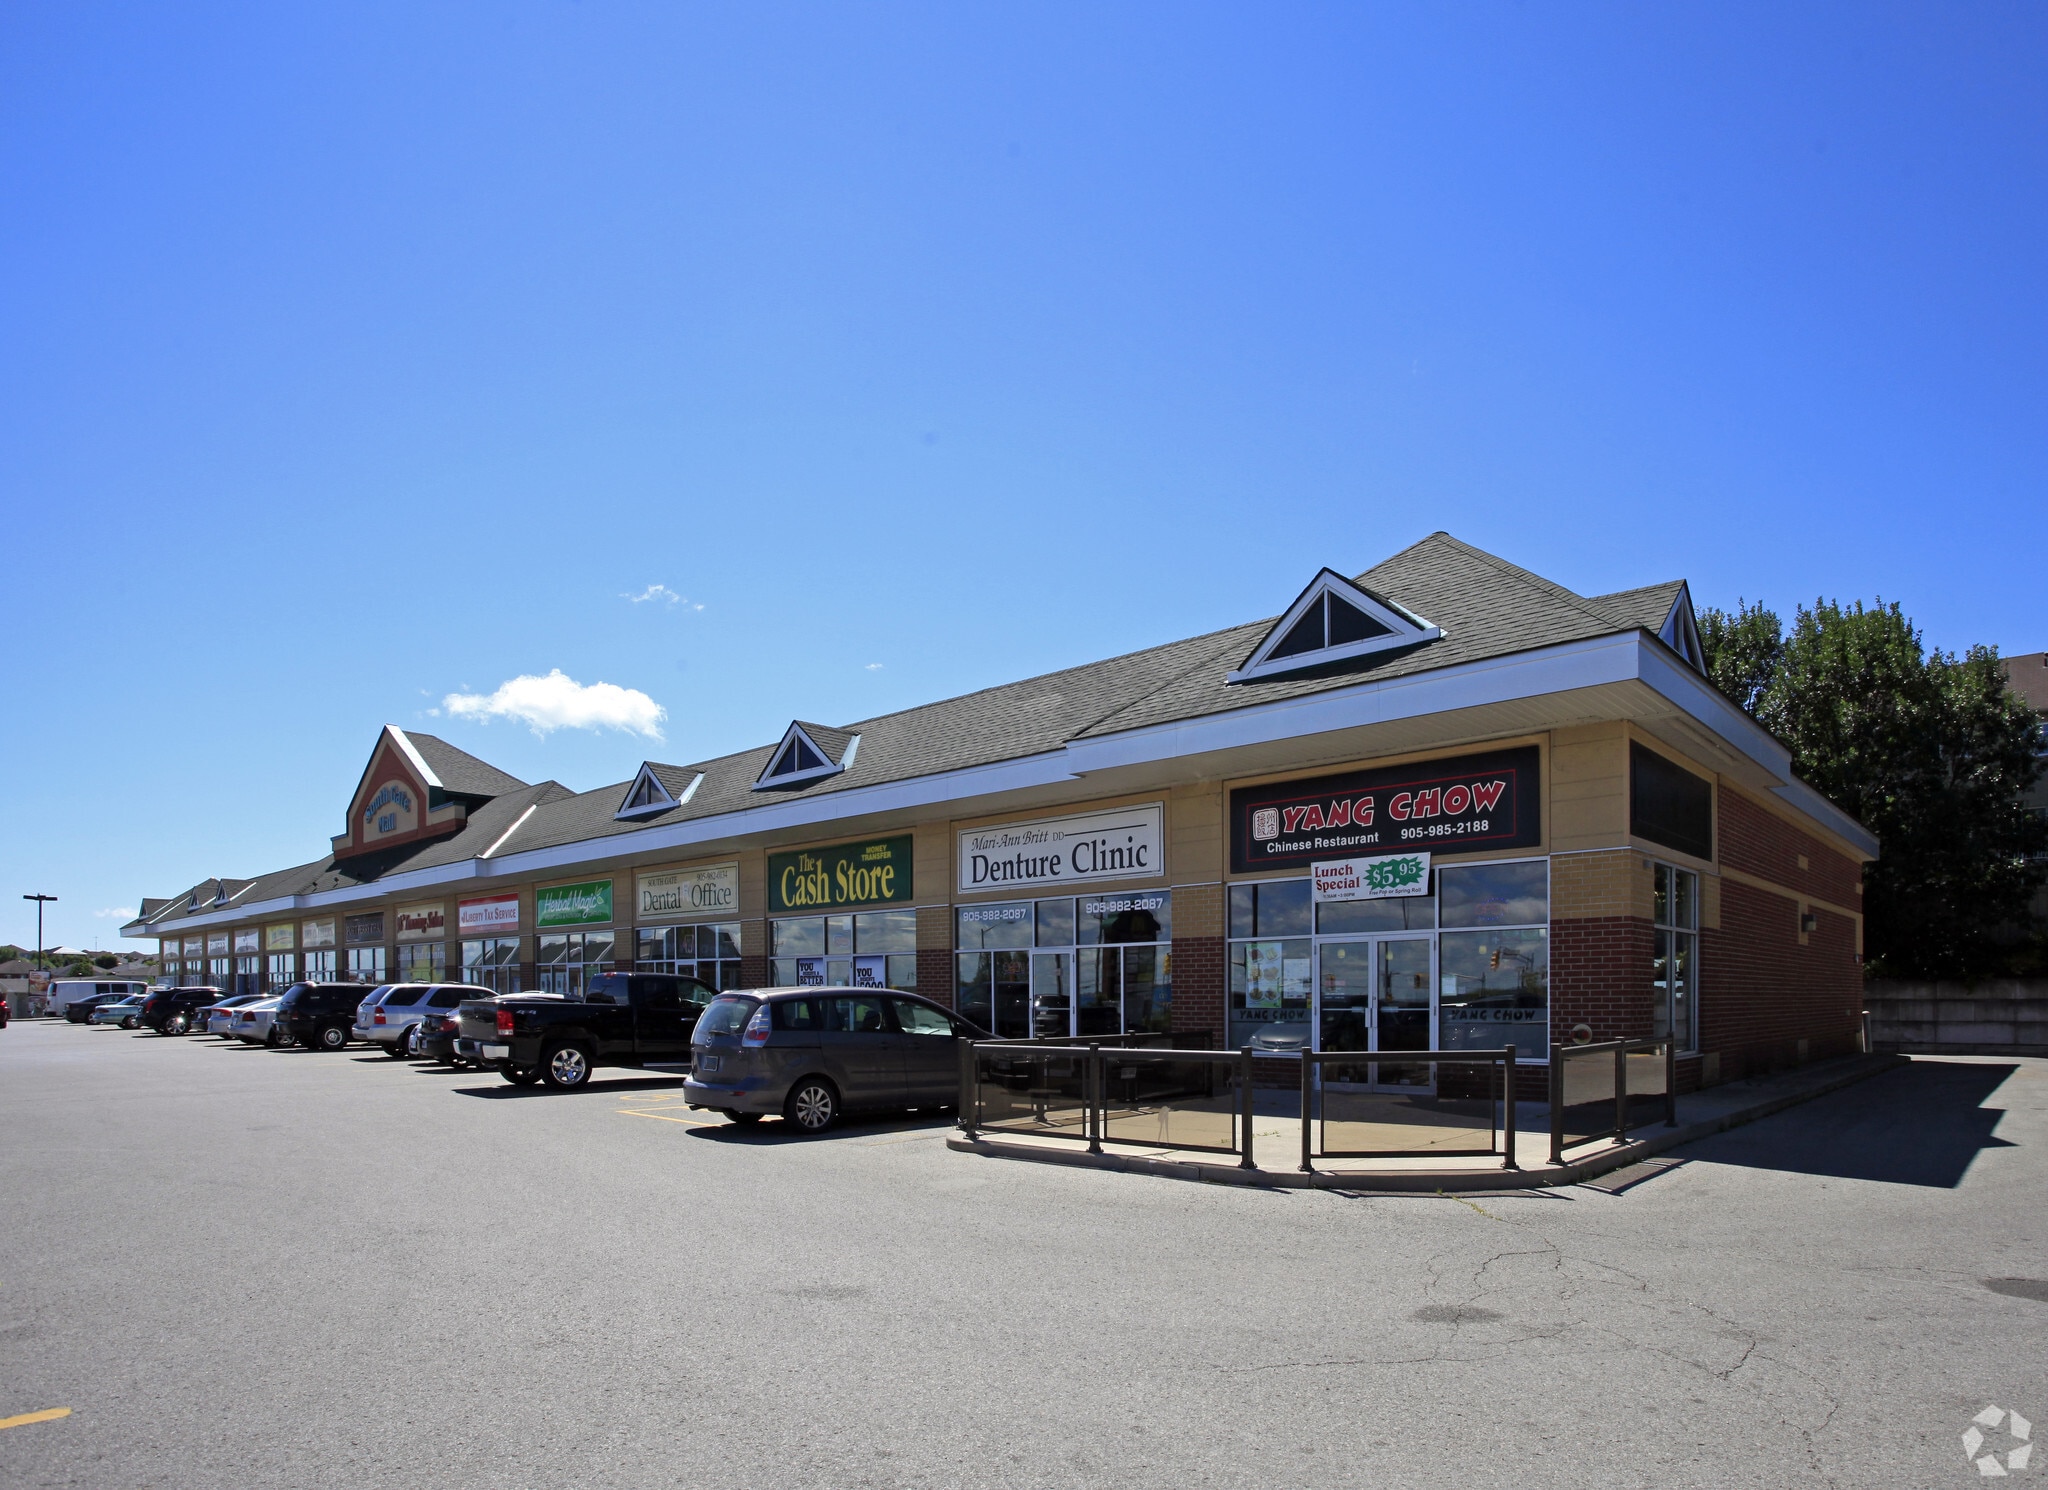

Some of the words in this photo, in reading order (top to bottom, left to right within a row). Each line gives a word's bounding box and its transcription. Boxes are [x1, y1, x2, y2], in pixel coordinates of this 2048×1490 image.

[1283, 796, 1375, 833] YANG
[1389, 780, 1506, 821] CHOW
[1400, 820, 1490, 840] 905-985-2188
[971, 832, 1021, 851] Mari-Ann
[1022, 829, 1049, 845] Britt
[1052, 831, 1065, 841] DD
[1266, 839, 1313, 853] Chinese
[1314, 831, 1380, 849] Restaurant
[861, 850, 892, 861] TRANSFER
[866, 844, 887, 854] MONEY
[799, 853, 815, 872] The
[971, 853, 1061, 883] Denture
[1072, 836, 1148, 873] Clinic
[1315, 864, 1353, 878] Lunch
[1373, 862, 1417, 884] $5.95
[781, 859, 831, 907] Cash
[836, 859, 895, 903] Store
[1316, 876, 1360, 892] Special
[1395, 887, 1411, 895] Spring
[572, 889, 597, 918] Magic
[643, 886, 681, 911] Dental
[691, 882, 731, 907] Office
[484, 908, 493, 920] TAX
[494, 906, 516, 920] SERVICE
[1086, 897, 1163, 914] 905-982-2087
[963, 908, 1027, 922] 905-982-2087
[800, 962, 814, 971] YOU
[857, 968, 872, 977] YOU
[800, 975, 823, 985] BETTER
[1240, 1010, 1268, 1019] YANG
[1272, 1009, 1305, 1019] CHOW
[1451, 1010, 1488, 1021] YANG
[1493, 1009, 1536, 1020] CHOW
